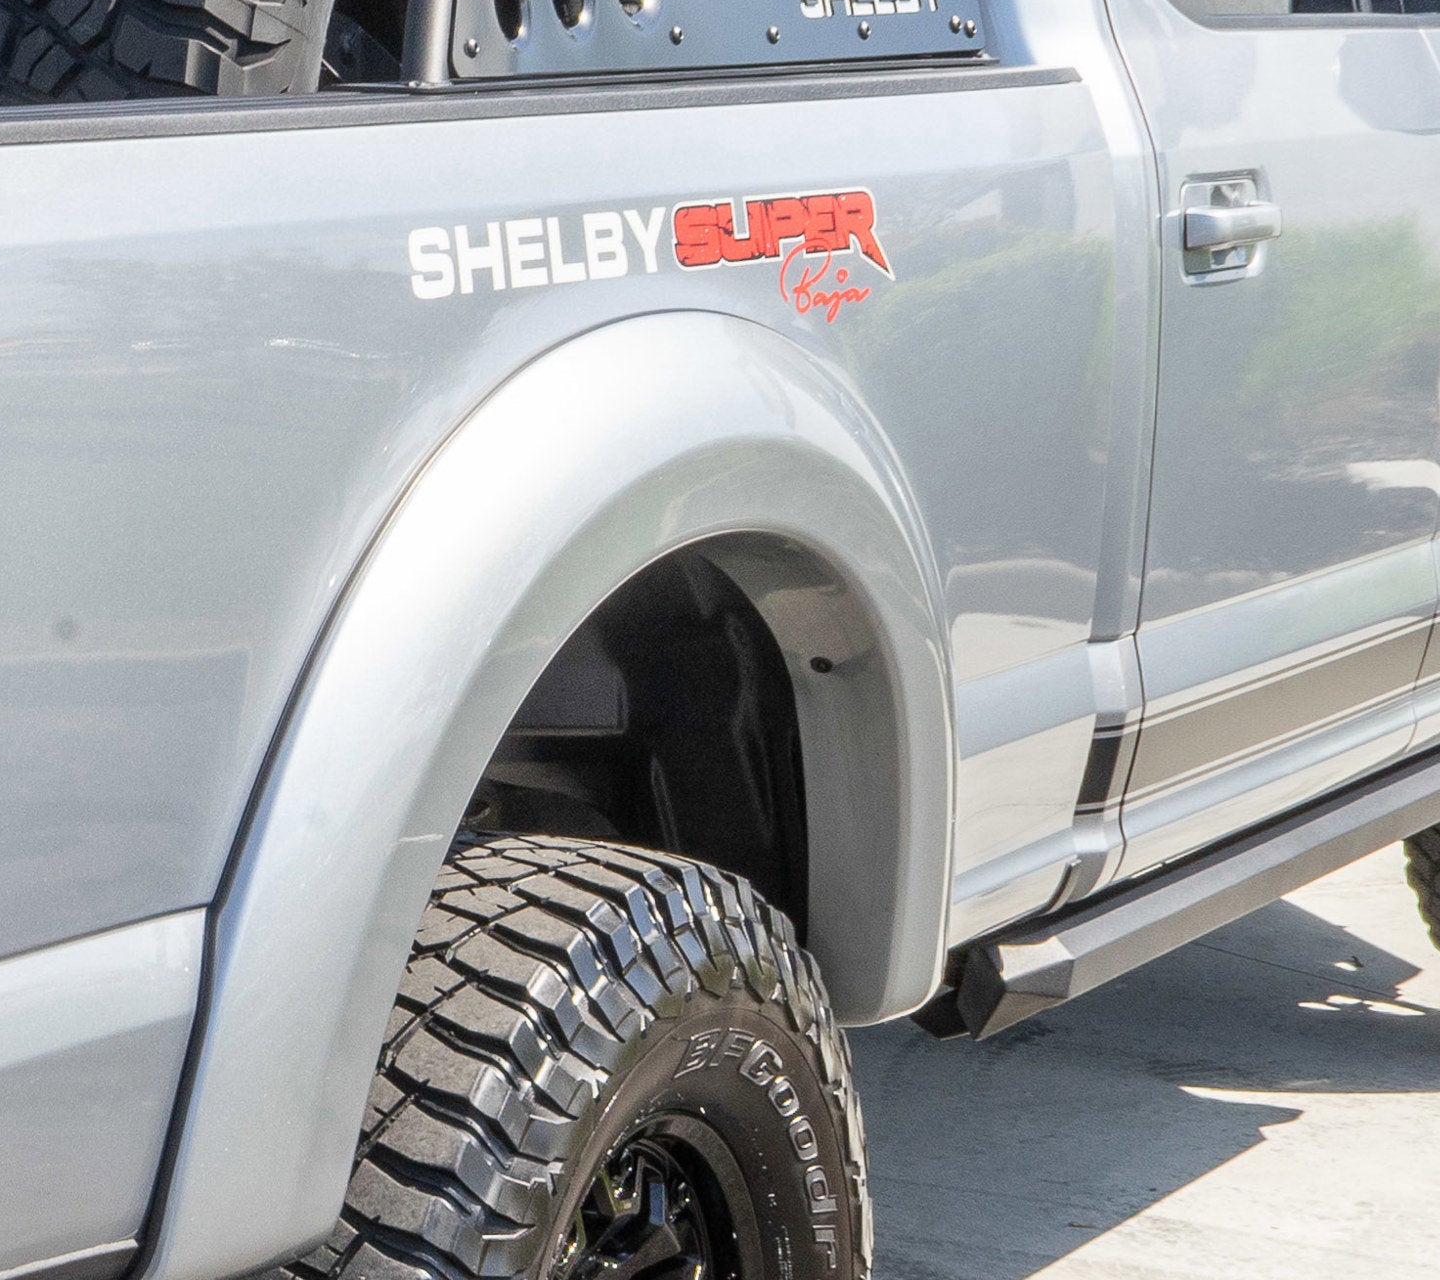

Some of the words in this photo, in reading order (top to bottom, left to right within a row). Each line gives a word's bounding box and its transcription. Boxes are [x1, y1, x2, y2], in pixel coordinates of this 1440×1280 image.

[407, 206, 666, 299] SHELBY
[672, 186, 896, 281] SUPER
[780, 238, 871, 323] Baja
